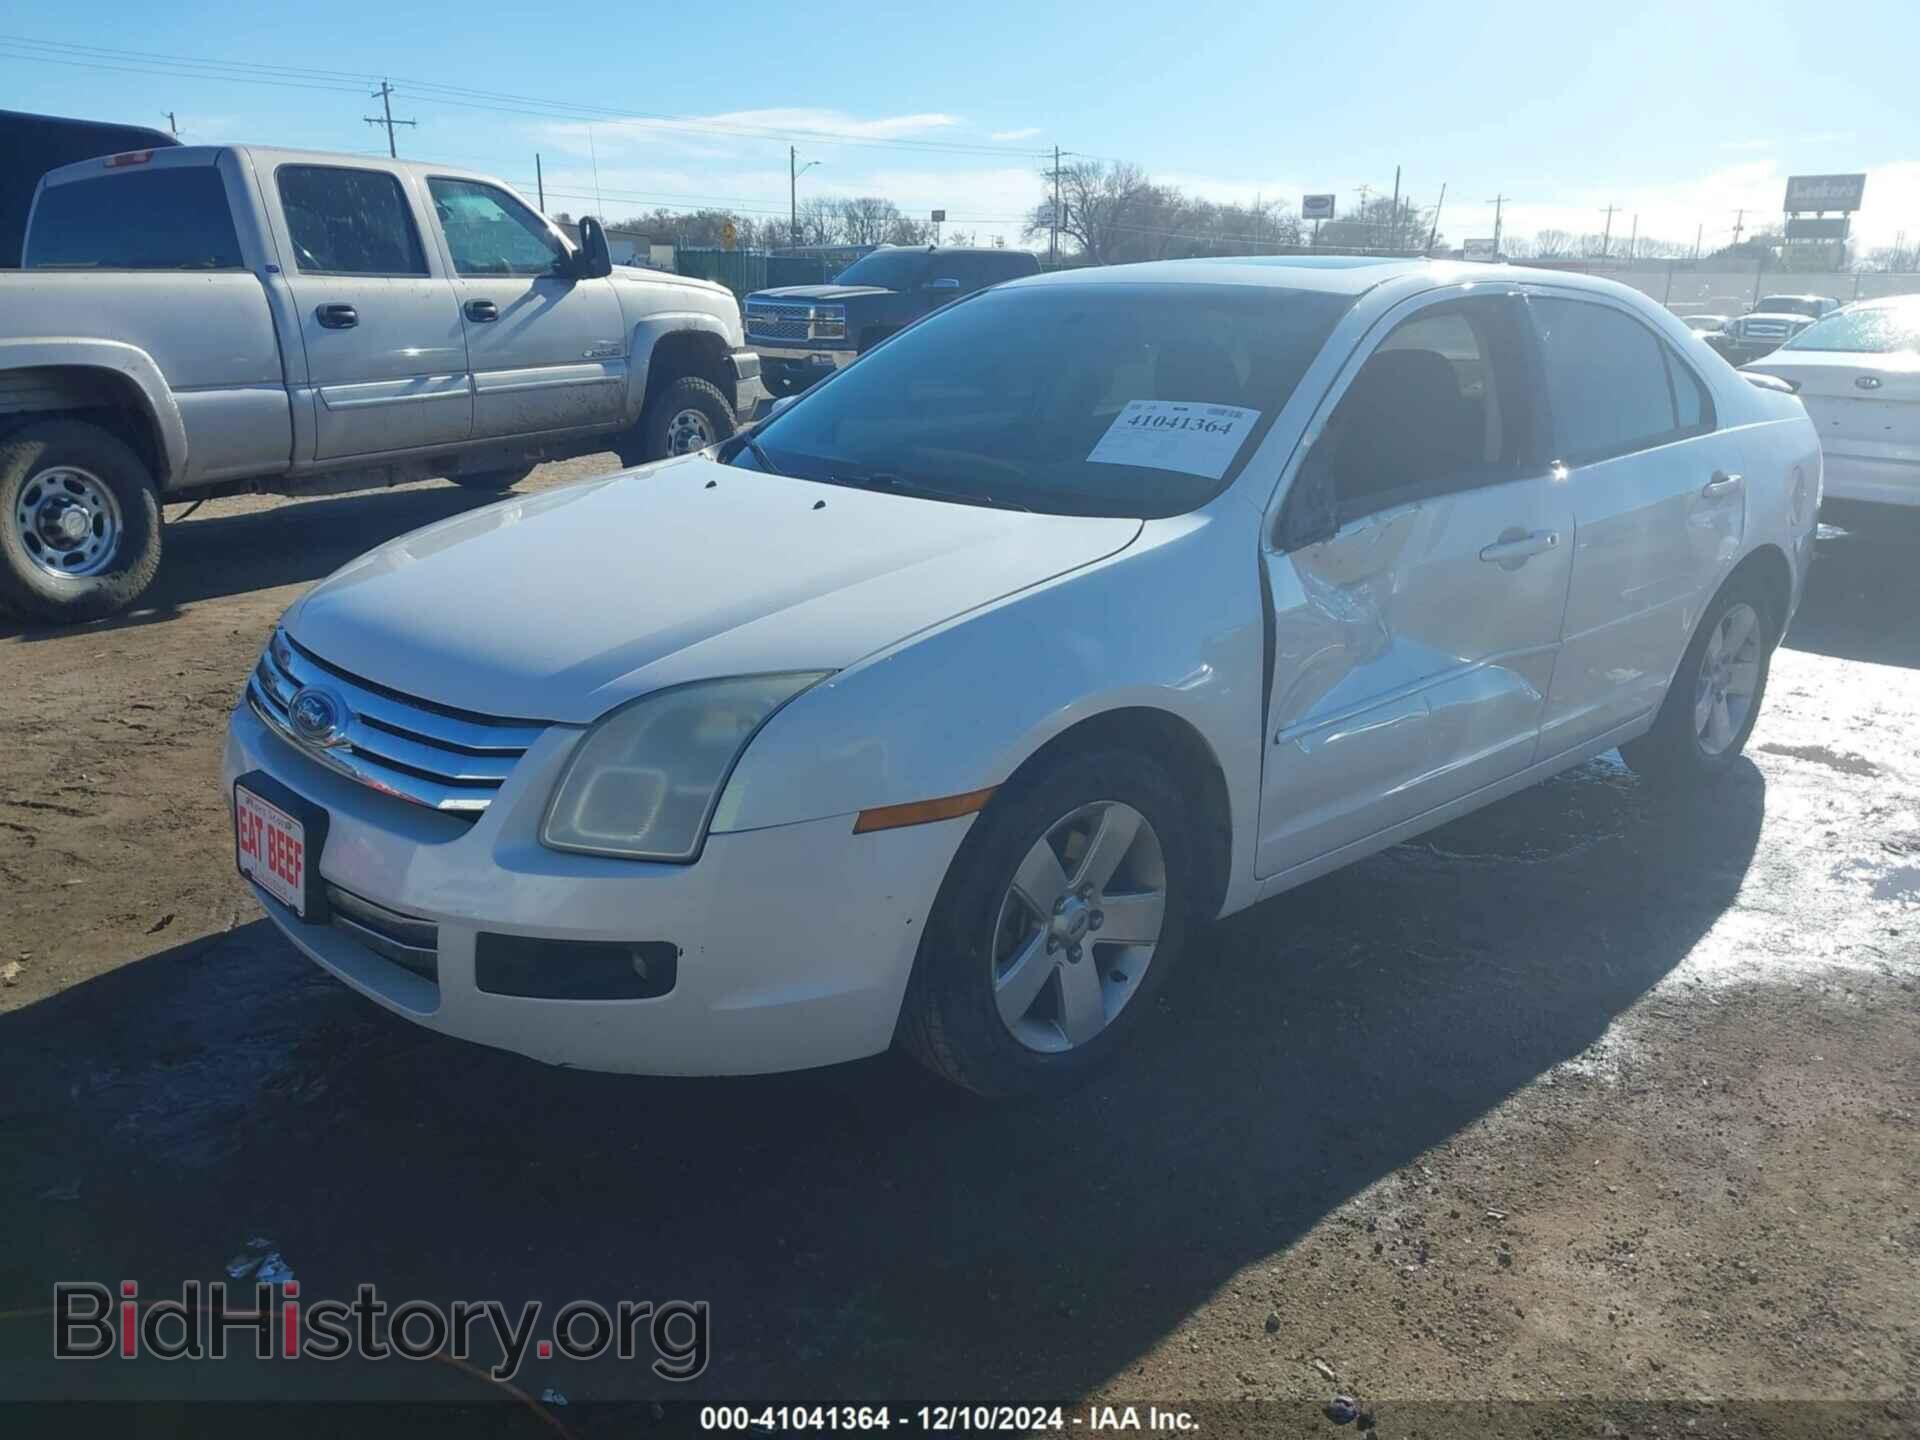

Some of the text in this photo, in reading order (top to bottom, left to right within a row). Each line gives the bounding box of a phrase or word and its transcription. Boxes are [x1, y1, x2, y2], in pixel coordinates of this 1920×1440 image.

[1128, 414, 1233, 435] 41041364
[239, 805, 263, 862] EAT
[267, 825, 304, 888] BEEF
